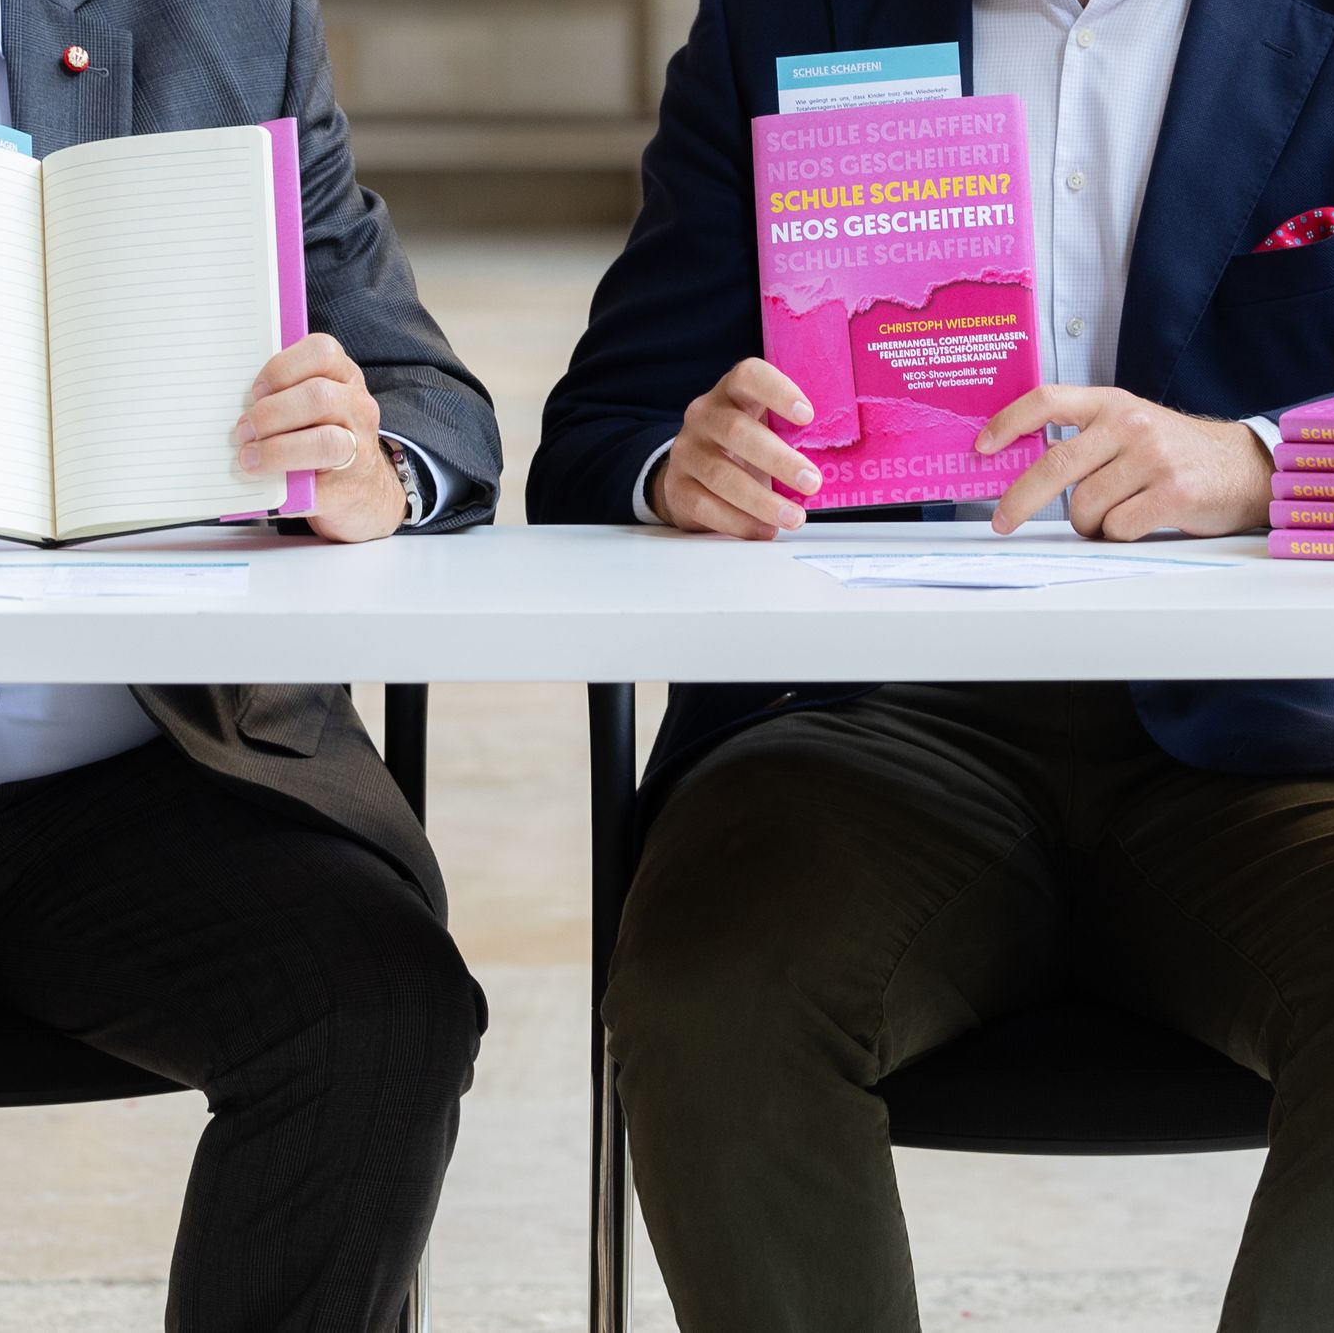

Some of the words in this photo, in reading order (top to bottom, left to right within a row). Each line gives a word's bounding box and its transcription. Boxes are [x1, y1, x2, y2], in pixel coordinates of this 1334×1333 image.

[793, 66, 829, 78] SCHULE
[767, 124, 860, 152] SCHULE
[867, 113, 1006, 143] SCHAFFEN?
[769, 157, 834, 182] NEOS
[840, 143, 1009, 176] GESCHEITERT!
[770, 183, 864, 213] SCHULE
[870, 173, 1011, 204] SCHAFFEN?
[771, 218, 838, 244] NEOS
[843, 204, 1014, 237] GESCHEITERT!
[774, 246, 867, 274] SCHULE
[874, 234, 1015, 265] SCHAFFEN?
[879, 320, 943, 335] CHRISTOPH
[946, 314, 1017, 329] WIEDERKEHR
[868, 338, 937, 351] LEHRERMANGEL,
[939, 331, 1028, 346] CONTAINERKLASSEN,
[880, 350, 921, 359] FEHLENDE
[922, 342, 1017, 357] DEUTSCHFÖRDERUNG,
[891, 357, 928, 368] GEWALT,
[929, 352, 1007, 365] FÖRDERSKANDALE
[903, 368, 977, 381] NEOS-Showpolitik
[979, 367, 997, 375] statt
[908, 381, 933, 390] echter
[936, 377, 993, 388] Verbesserung
[820, 461, 854, 483] OS
[860, 448, 1030, 480] GESCHEITERT!
